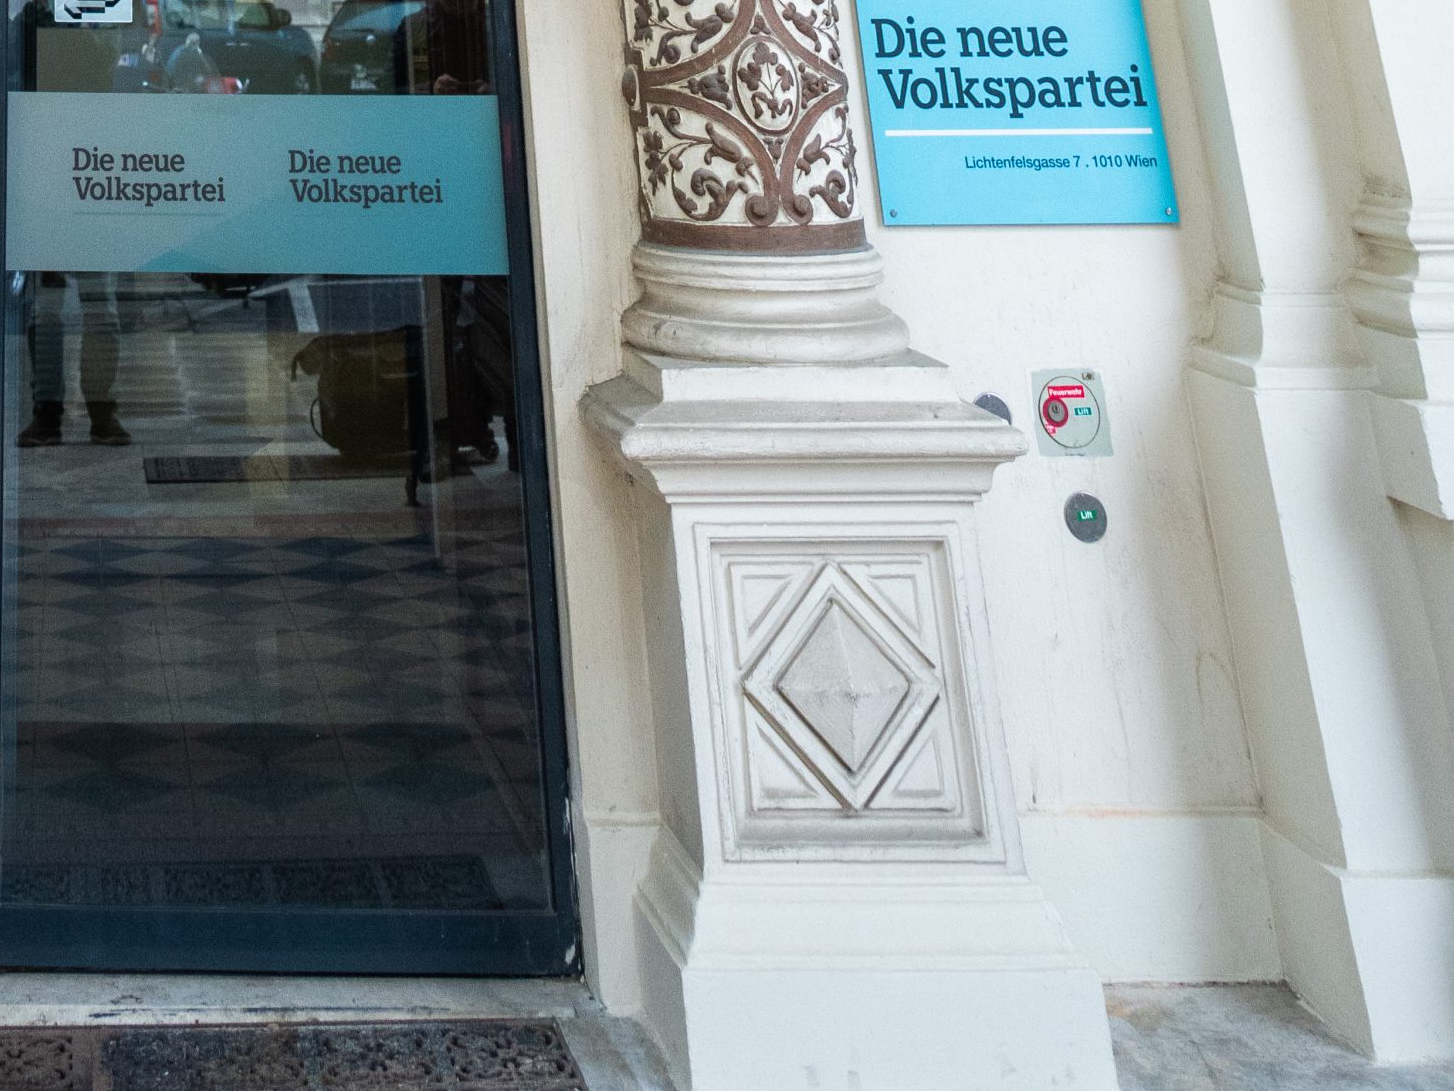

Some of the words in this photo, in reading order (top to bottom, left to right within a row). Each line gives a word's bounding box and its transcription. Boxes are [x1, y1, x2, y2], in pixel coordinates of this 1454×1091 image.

[870, 15, 947, 59] Die
[956, 25, 1069, 58] neue
[877, 64, 1148, 119] Volkspartei
[72, 146, 115, 172] Die
[121, 153, 185, 172] neue
[288, 149, 331, 174] Die
[337, 155, 402, 174] neue
[964, 155, 1071, 171] Lichtenfelsgasse
[1072, 155, 1081, 168] 7
[1091, 155, 1123, 168] 1010
[1125, 154, 1158, 168] Wien
[72, 176, 226, 207] Volkspartei
[289, 178, 444, 209] Volkspartei
[1048, 388, 1082, 396] Feuerwehr
[1080, 510, 1093, 519] Lift
